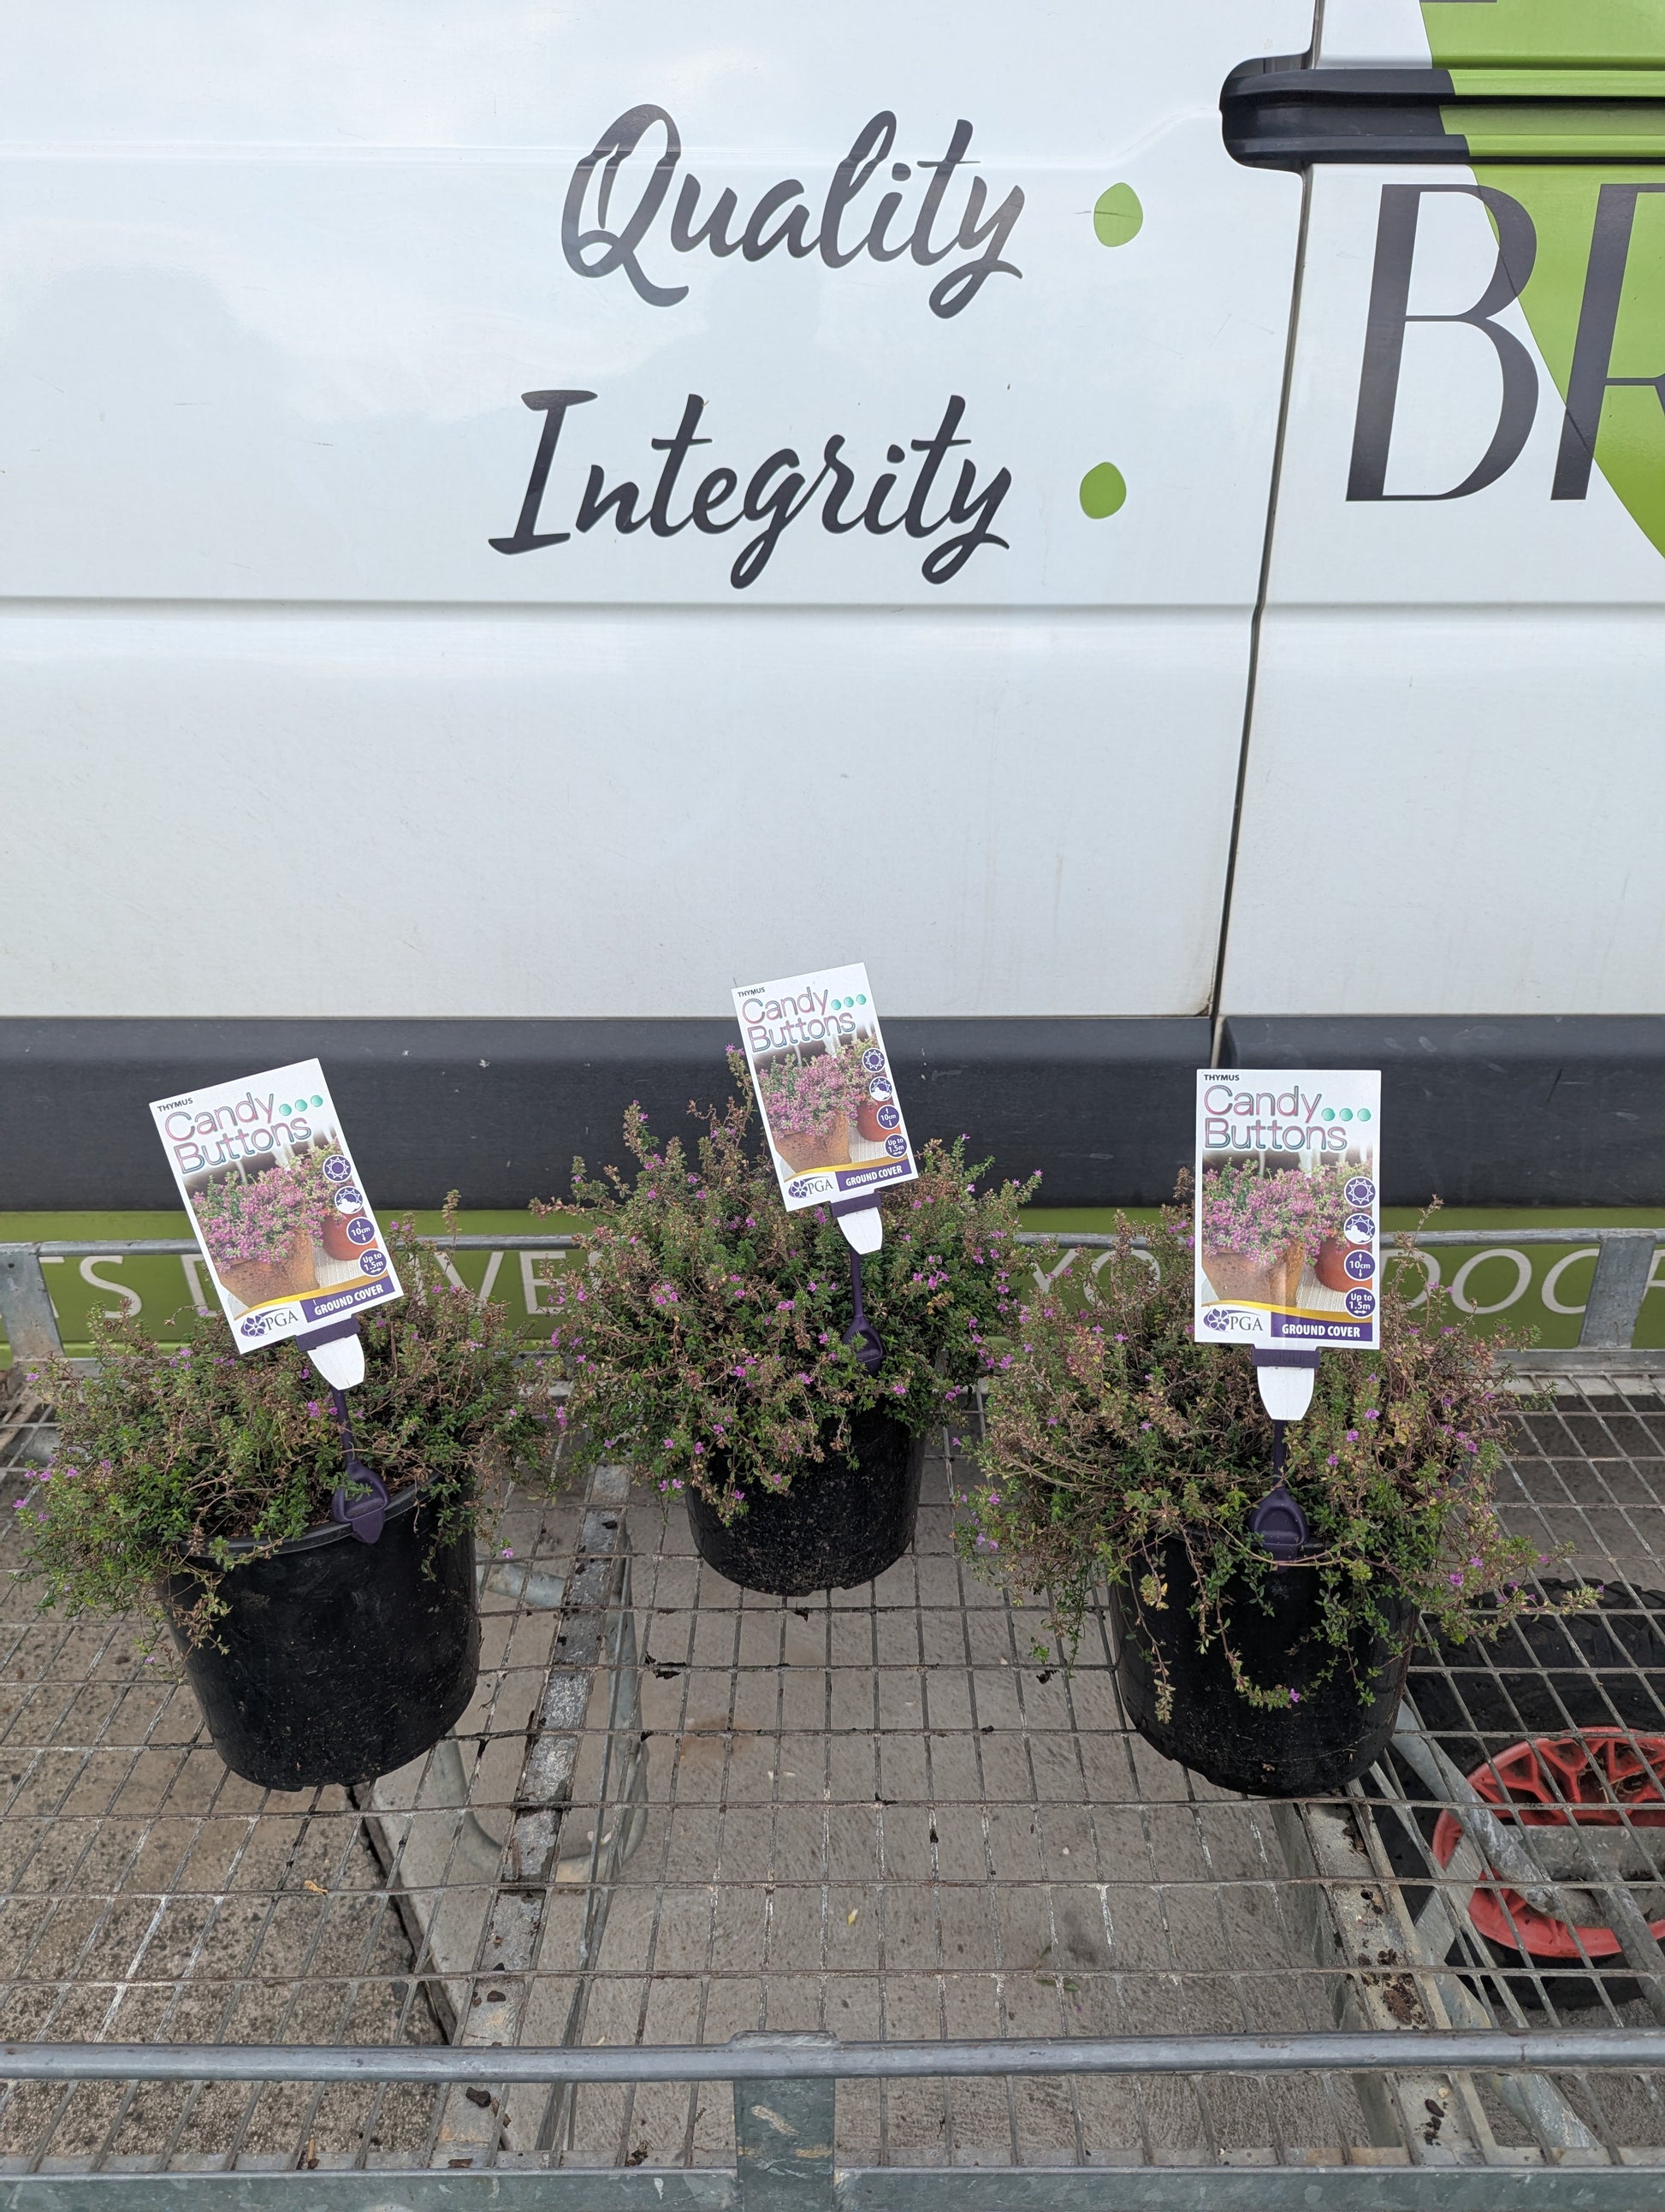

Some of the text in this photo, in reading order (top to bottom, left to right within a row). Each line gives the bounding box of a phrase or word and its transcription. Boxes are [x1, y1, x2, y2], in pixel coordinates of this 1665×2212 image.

[560, 104, 1025, 319] Quality
[488, 389, 1012, 589] Integrity
[738, 987, 765, 998] THYMUS
[742, 986, 828, 1024] Candy
[747, 1011, 856, 1053] Buttons
[157, 1098, 193, 1112] THYMUS
[1204, 1085, 1322, 1123] Candy
[165, 1092, 275, 1142] Candy
[1204, 1118, 1348, 1151] Buttons
[174, 1117, 311, 1174] Buttons
[887, 1139, 897, 1148] Up
[888, 1144, 904, 1153] 1.5m
[845, 1165, 903, 1187] GROUND COVER
[808, 1179, 833, 1195] PGA
[351, 1225, 370, 1237] 10cm
[362, 1255, 373, 1264] Up
[363, 1260, 383, 1271] 1.5m
[1349, 1261, 1371, 1270] 10cm
[314, 1284, 383, 1315] GROUND COVER
[1350, 1293, 1362, 1302] Up
[1348, 1302, 1371, 1310] 1.5m
[264, 1309, 299, 1331] PGA
[1230, 1317, 1263, 1331] PGA
[1282, 1324, 1360, 1337] GROUND COVER
